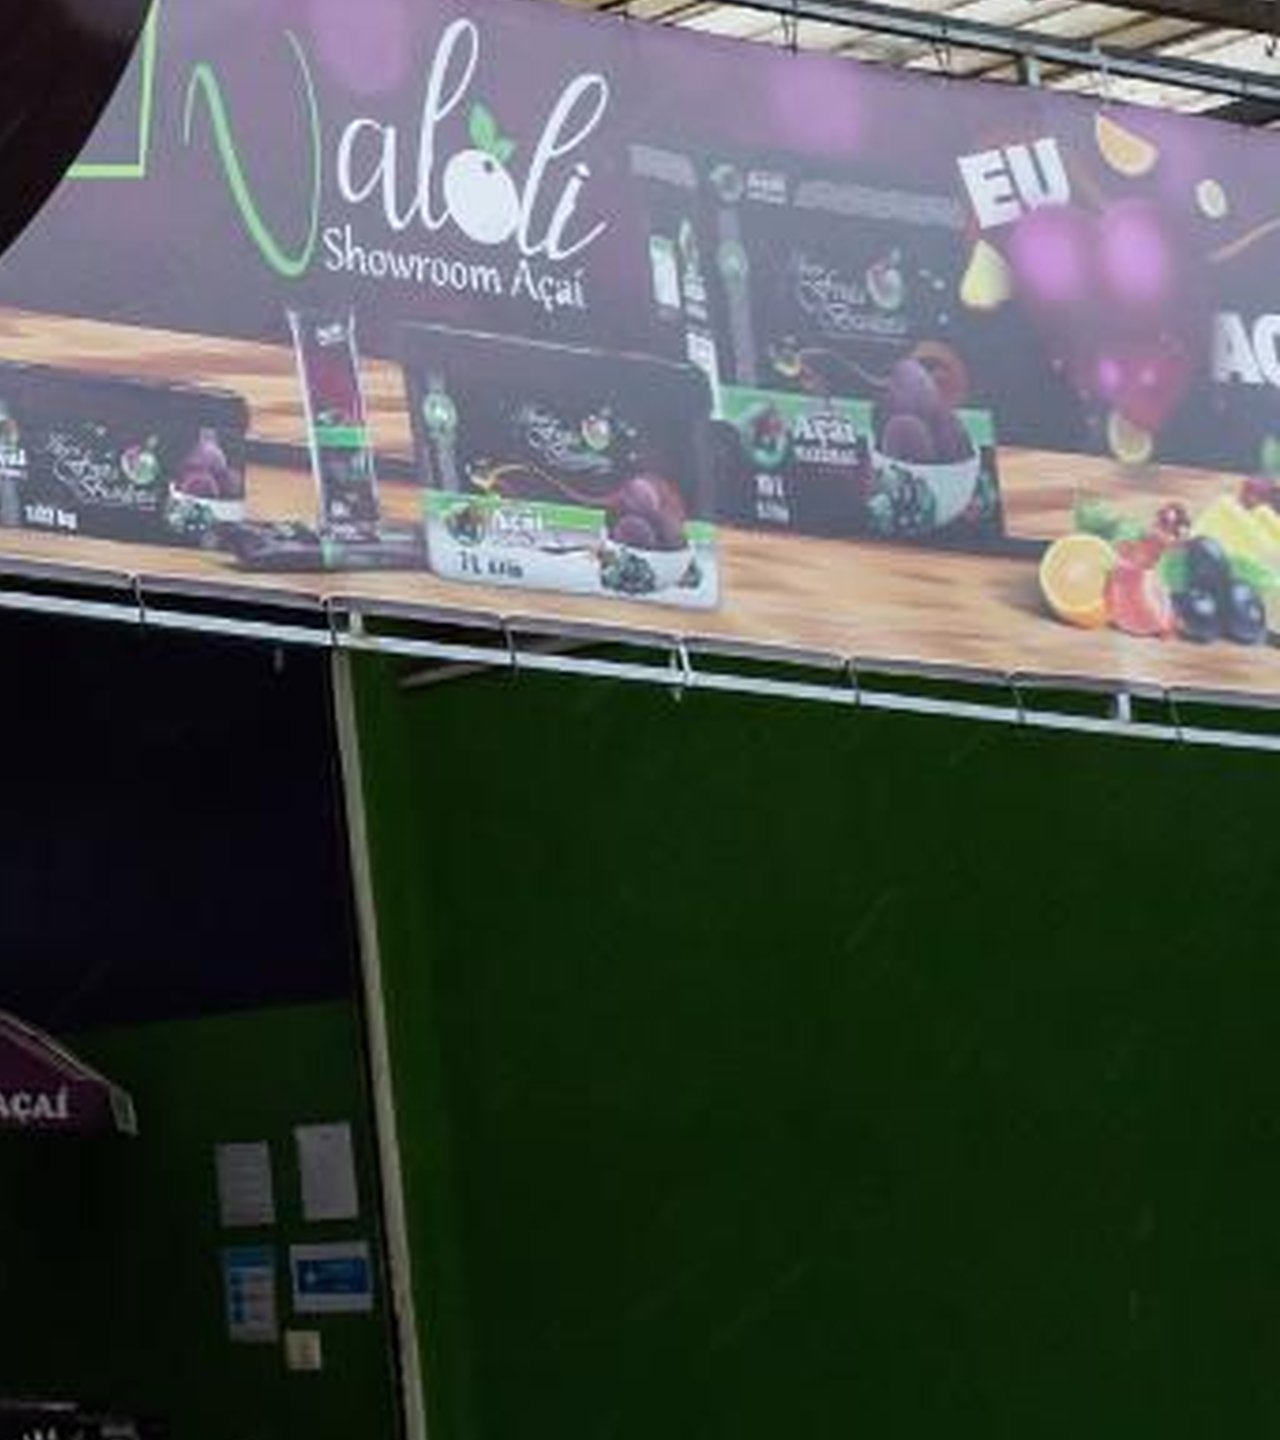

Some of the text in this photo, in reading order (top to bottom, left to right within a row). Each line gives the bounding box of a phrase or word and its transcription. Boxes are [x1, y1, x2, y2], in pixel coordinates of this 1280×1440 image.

[956, 137, 1071, 229] EU
[323, 225, 588, 311] Showroom Açaí
